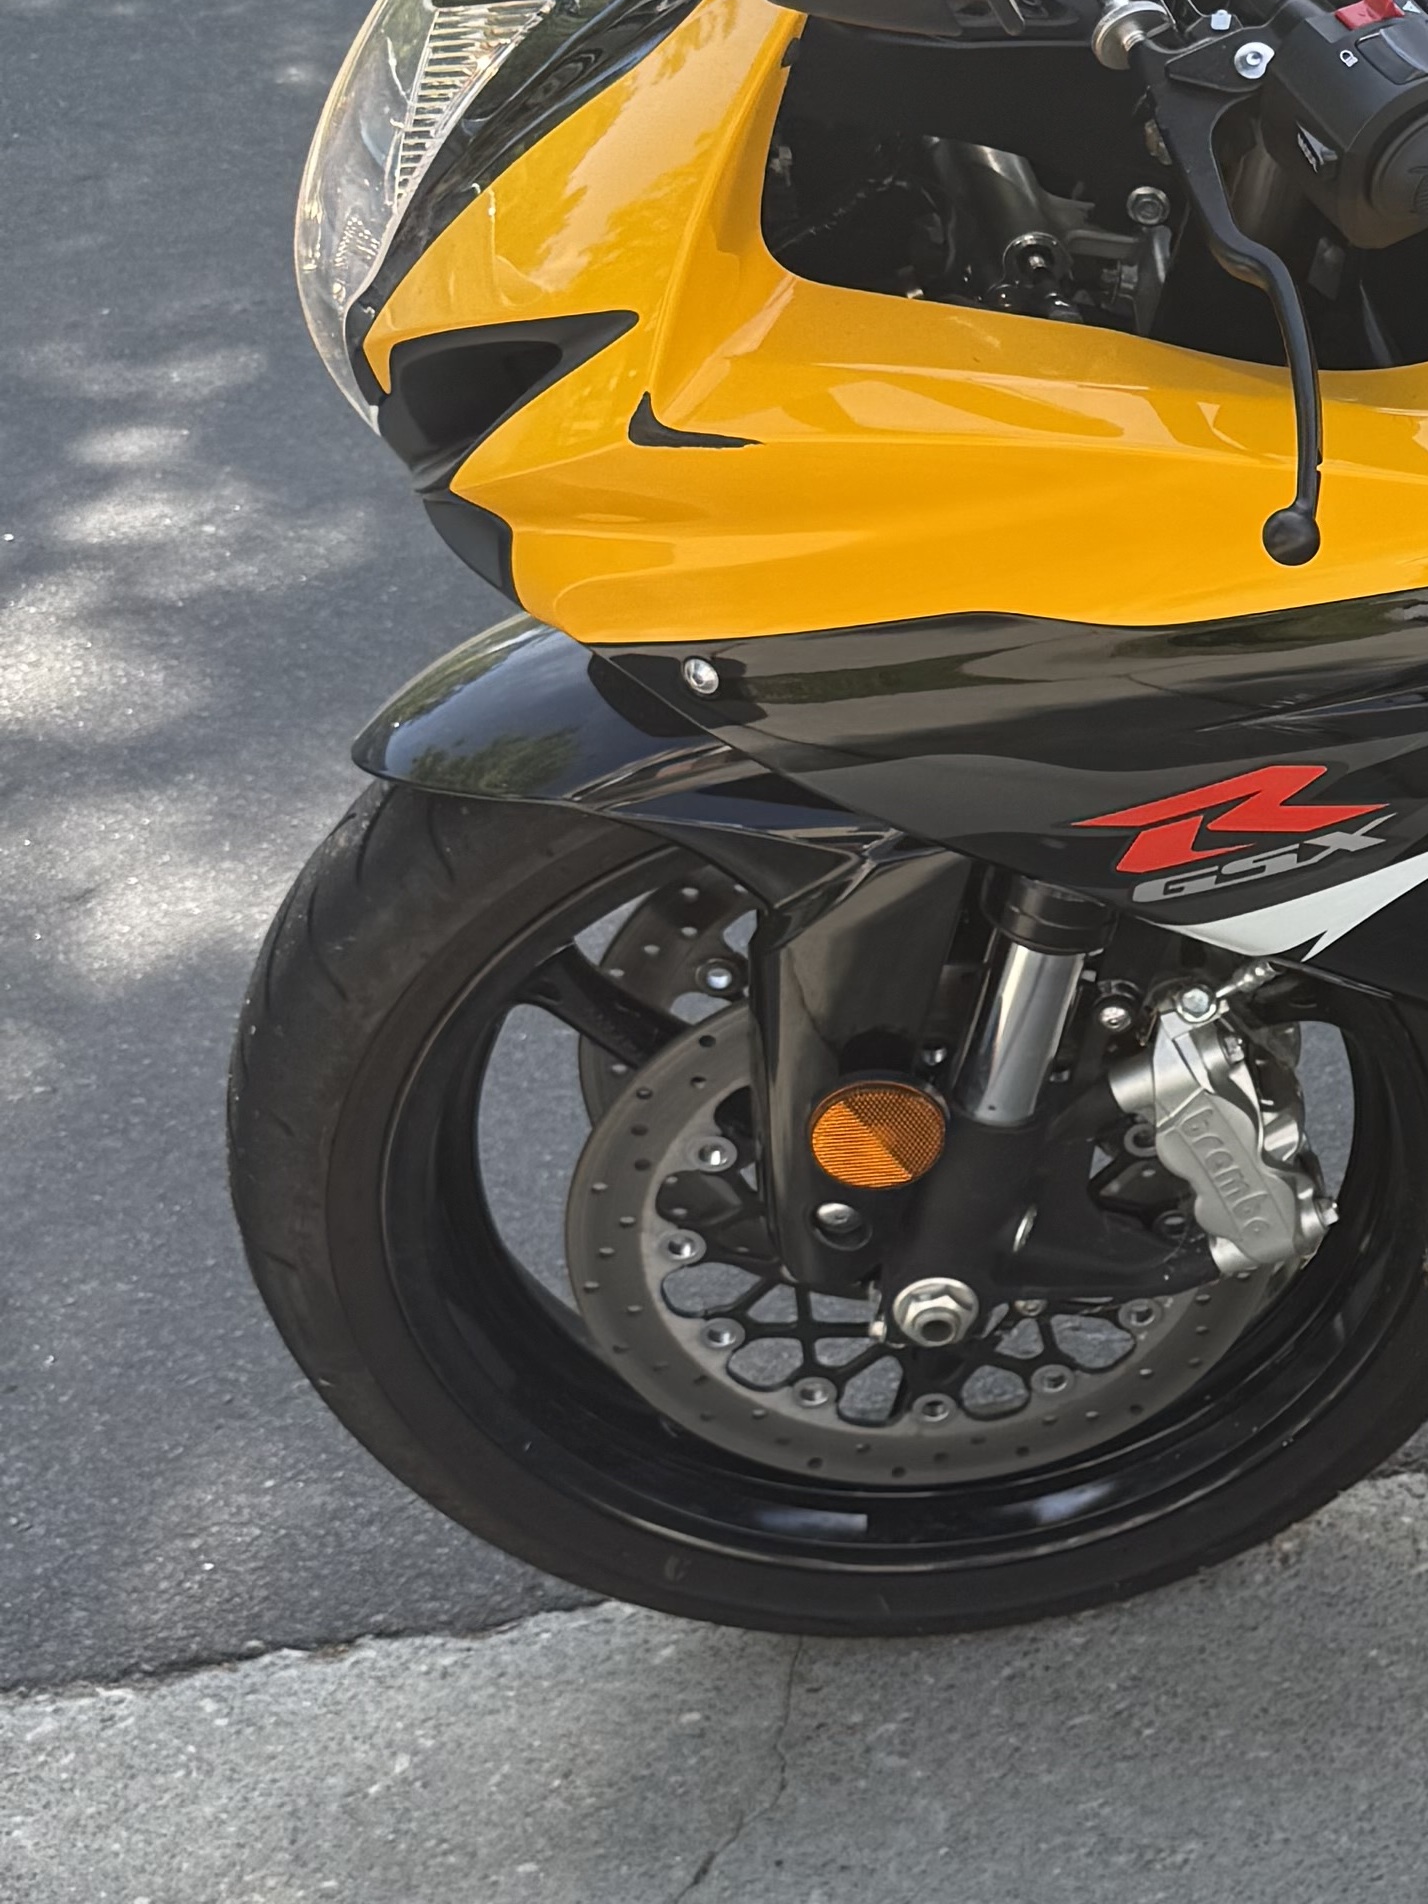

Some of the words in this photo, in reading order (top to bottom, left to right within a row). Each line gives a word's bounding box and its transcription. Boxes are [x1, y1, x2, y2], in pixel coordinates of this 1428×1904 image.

[1070, 765, 1390, 874] R
[1132, 812, 1397, 903] GSX
[1181, 1105, 1273, 1237] brembo
